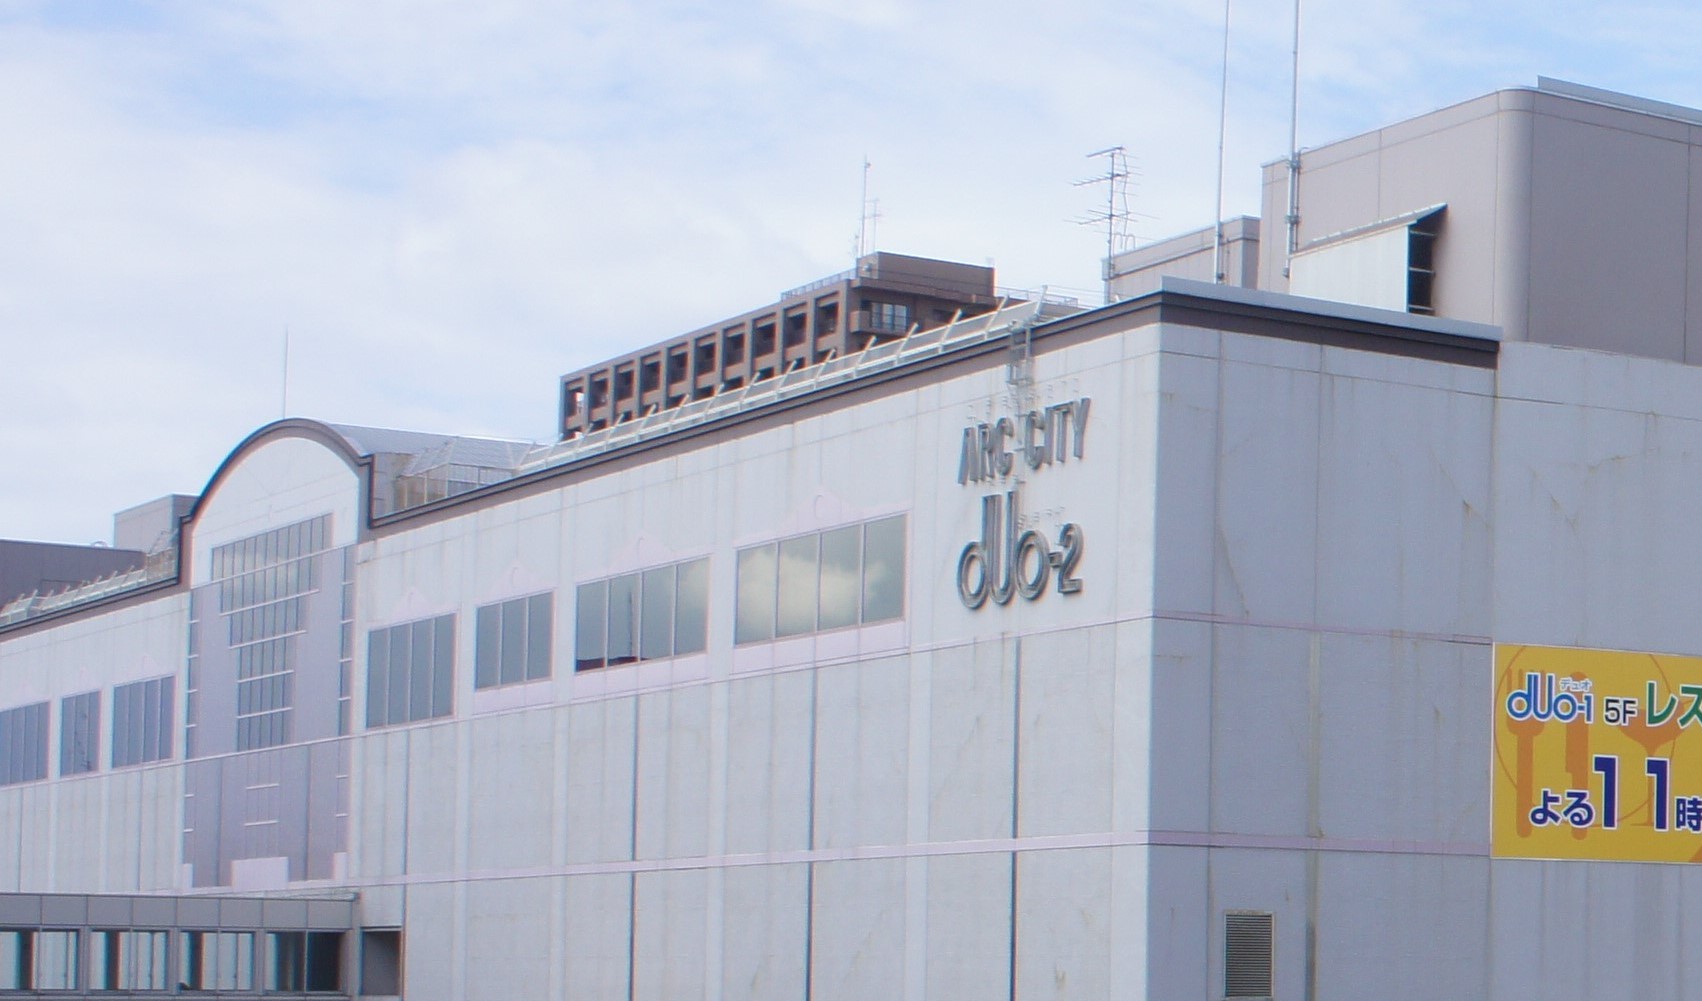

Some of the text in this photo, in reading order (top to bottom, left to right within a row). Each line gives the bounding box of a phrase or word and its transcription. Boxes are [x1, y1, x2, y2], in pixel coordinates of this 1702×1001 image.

[957, 397, 1092, 486] ARC CITY
[1559, 677, 1593, 691] デュオ
[1603, 696, 1638, 726] 5F
